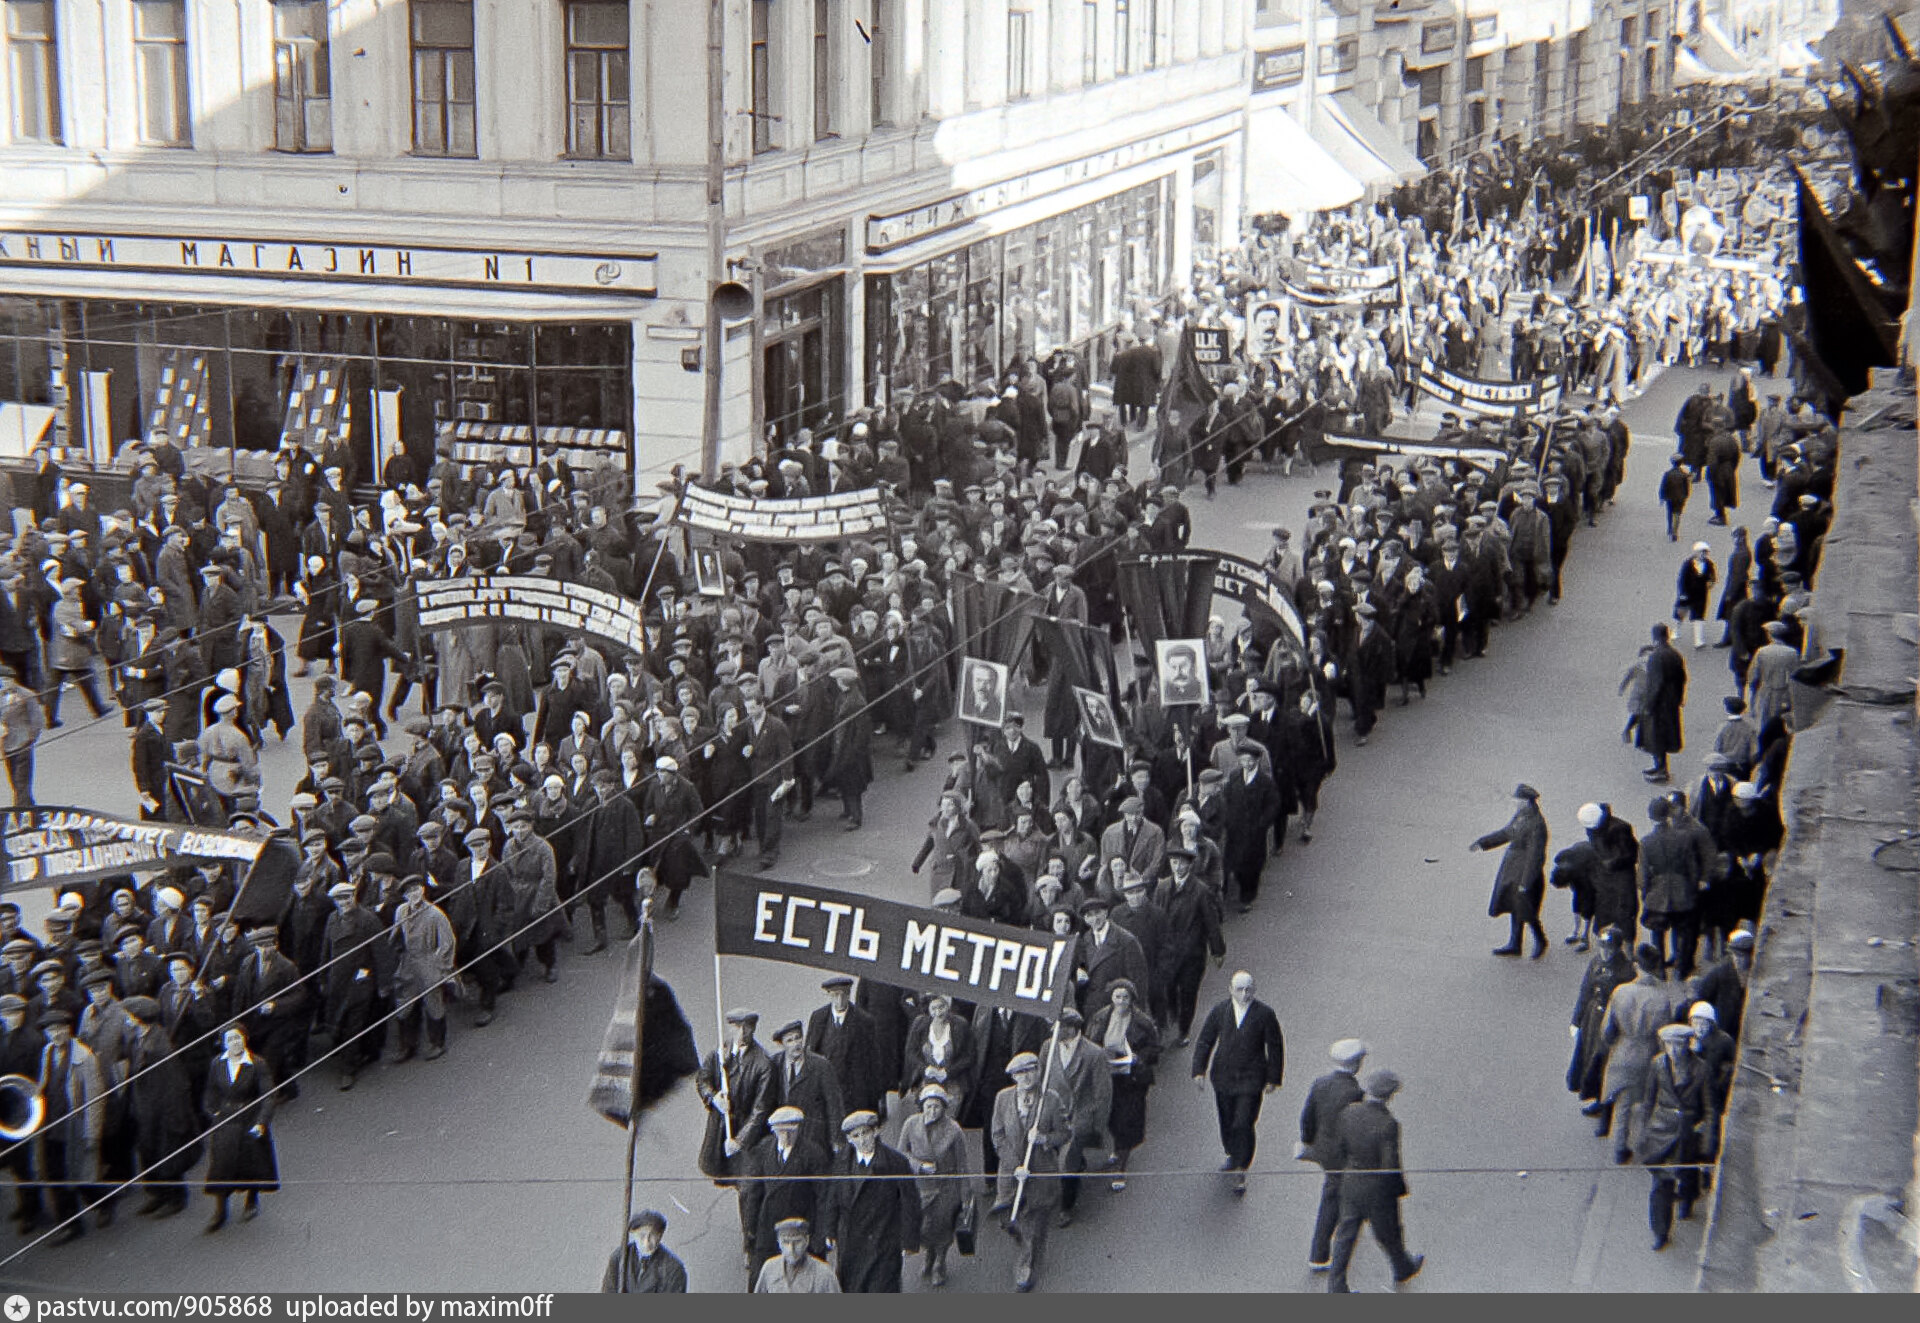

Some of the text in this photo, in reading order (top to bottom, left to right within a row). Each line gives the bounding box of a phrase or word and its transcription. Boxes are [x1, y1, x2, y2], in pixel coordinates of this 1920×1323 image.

[182, 241, 413, 276] МАГАЗИН
[754, 892, 1066, 1003] ЕСТЬ МЕТРО!
